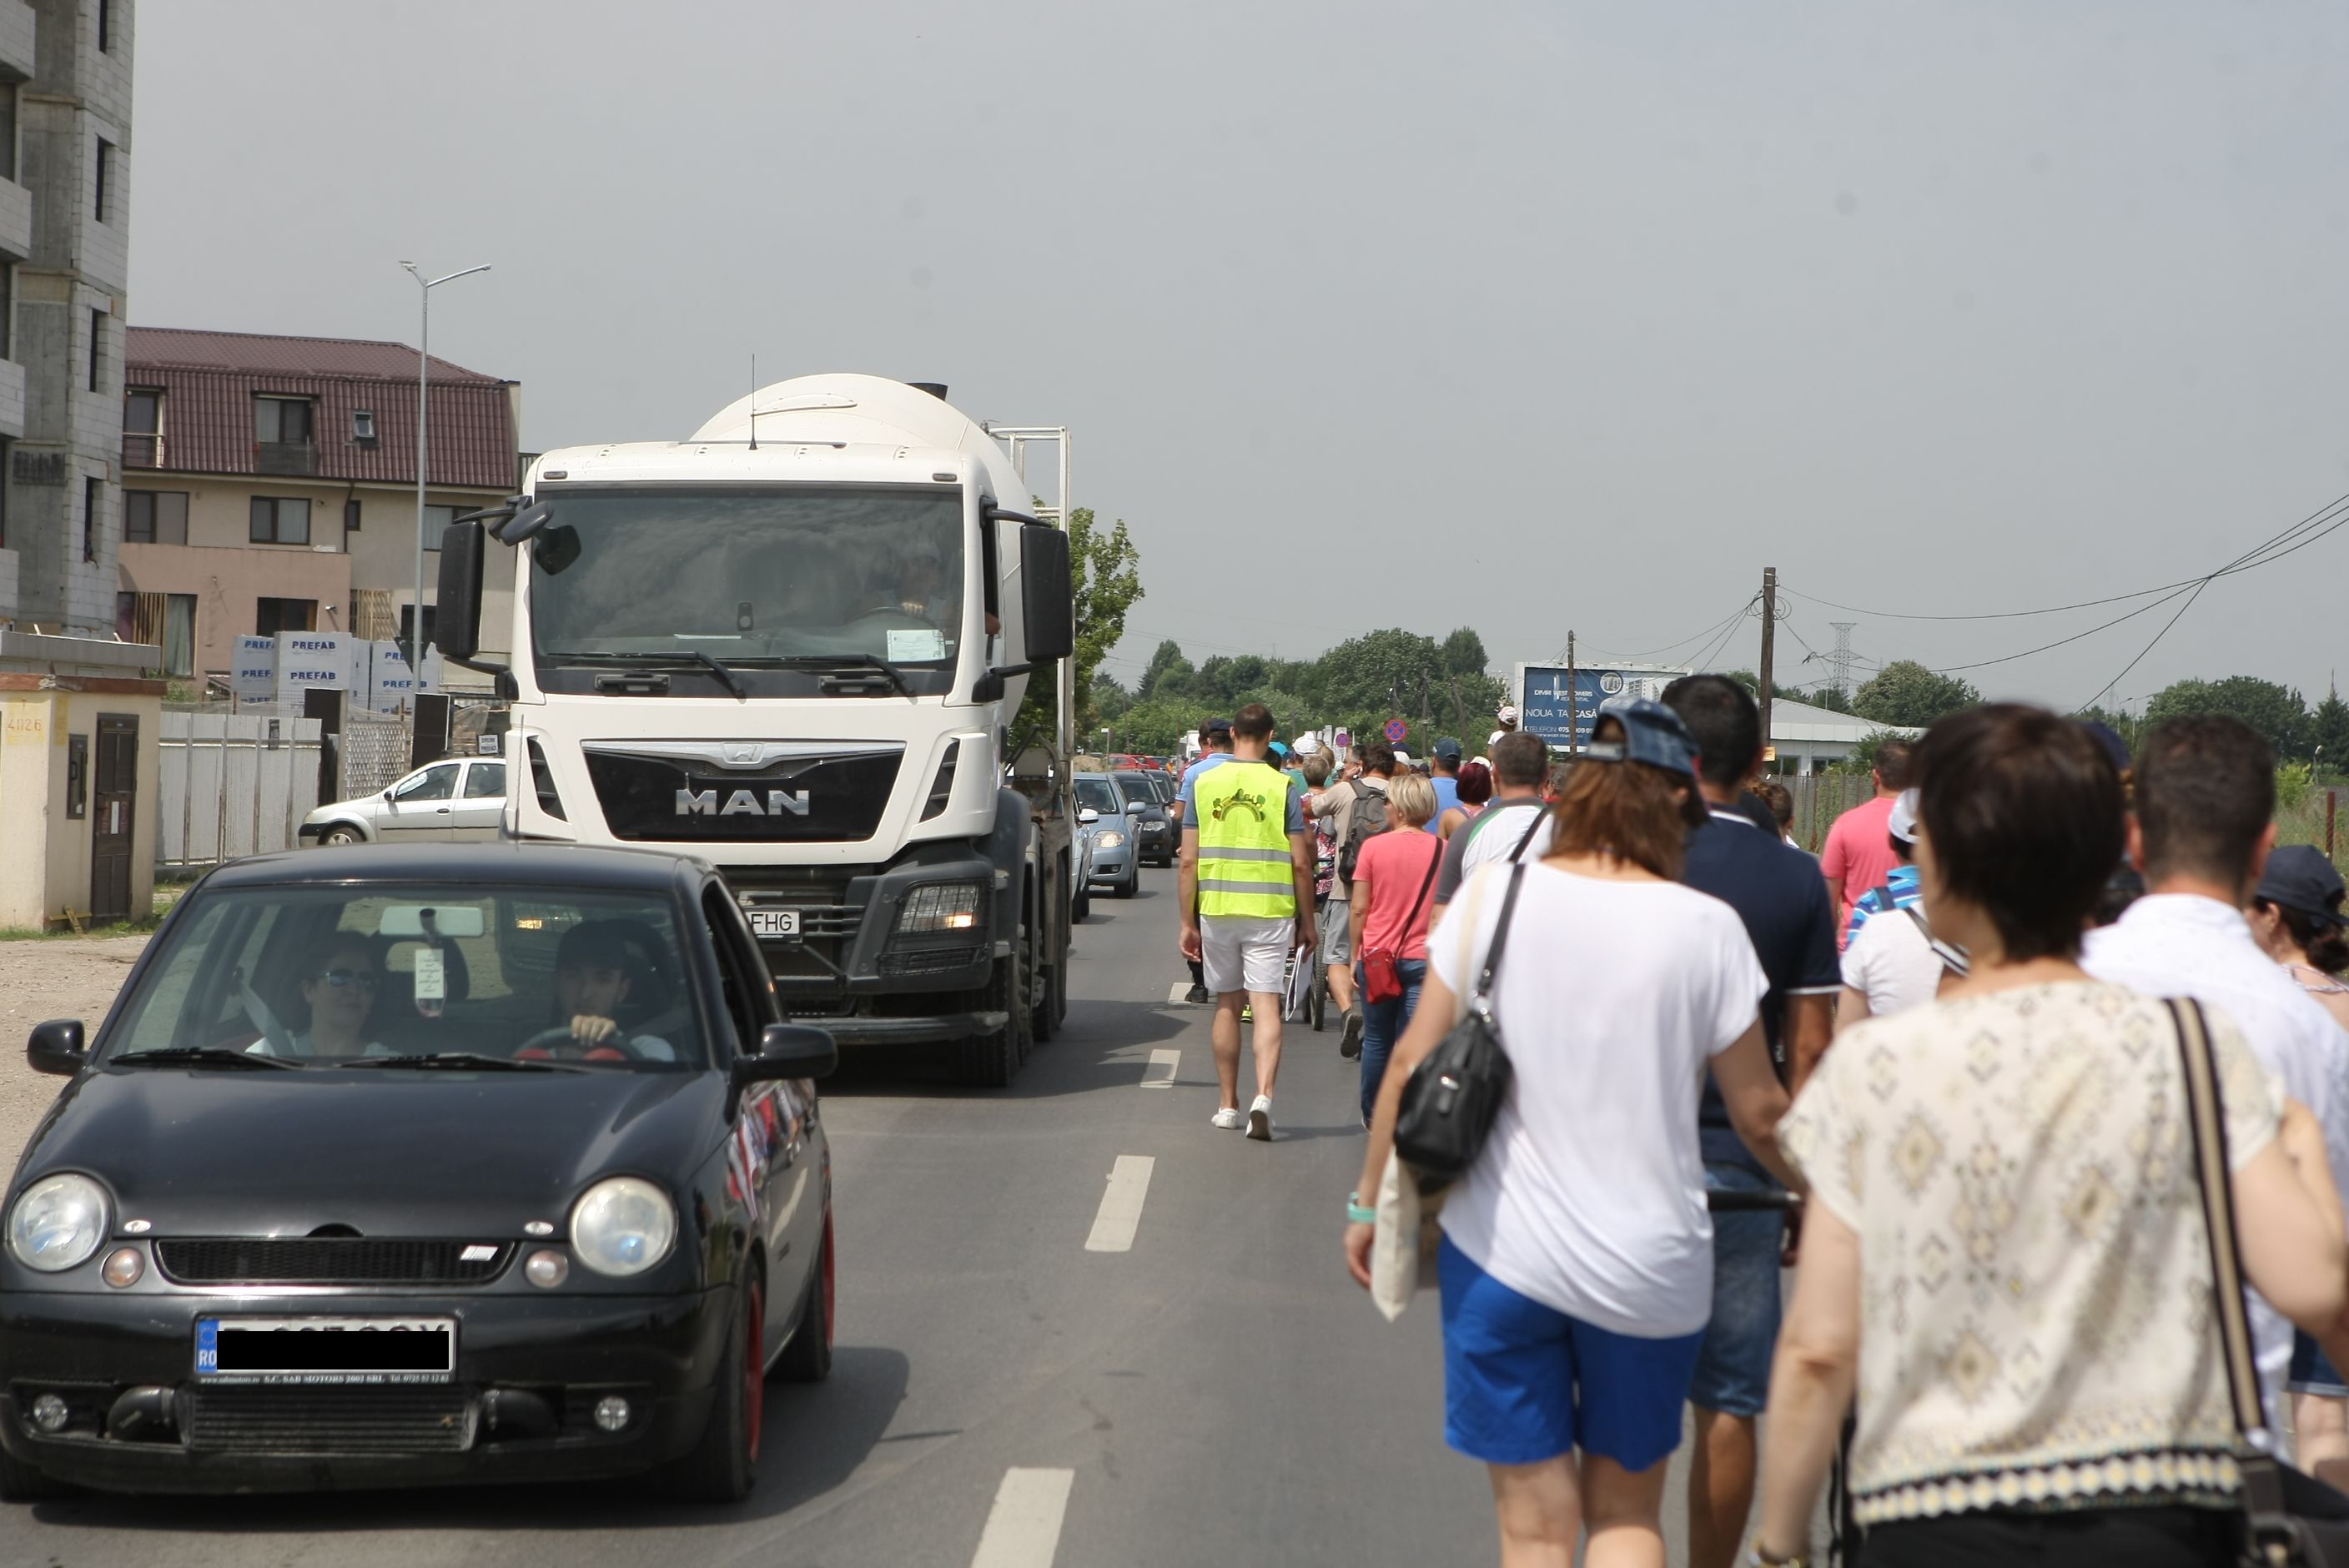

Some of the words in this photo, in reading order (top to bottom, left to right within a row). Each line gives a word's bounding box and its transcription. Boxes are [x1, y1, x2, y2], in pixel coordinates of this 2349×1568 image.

[292, 641, 336, 649] PREFAB
[290, 671, 335, 680] PREFAB
[1526, 708, 1554, 717] NOUA
[1557, 709, 1569, 717] TA
[676, 789, 809, 815] MAN
[752, 913, 792, 932] FHG
[199, 1349, 218, 1367] RO
[264, 1375, 282, 1384] S.C.
[304, 1375, 344, 1384] MOTORS
